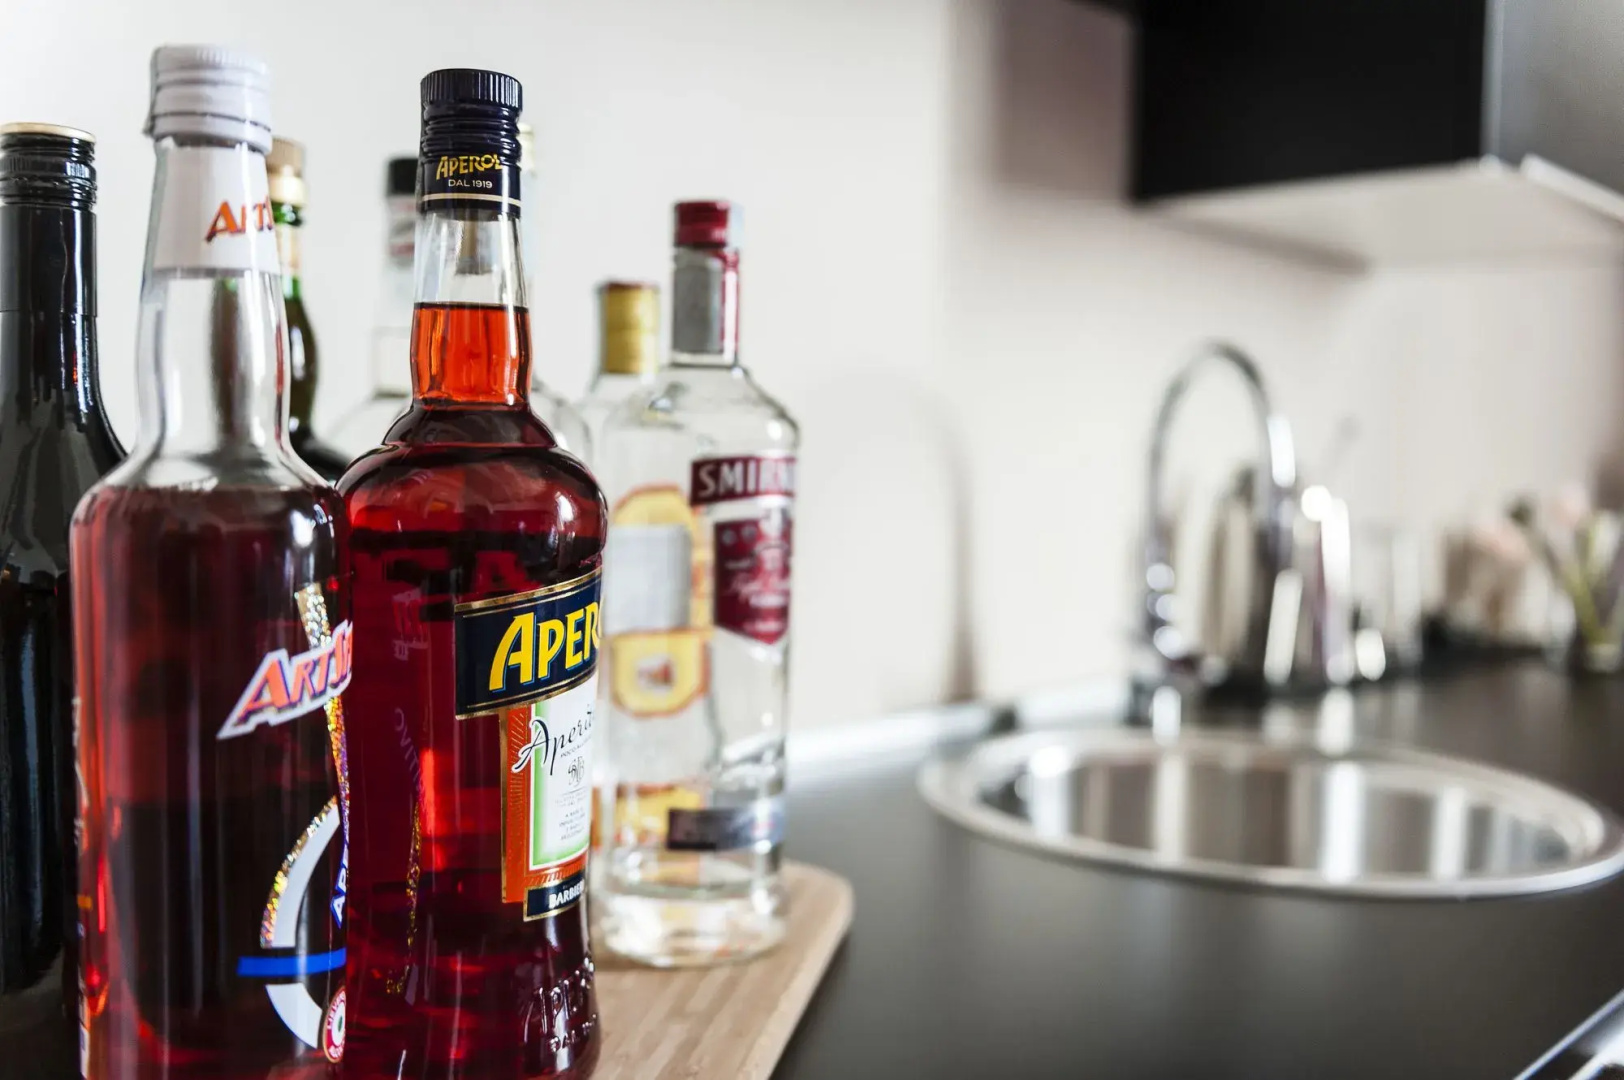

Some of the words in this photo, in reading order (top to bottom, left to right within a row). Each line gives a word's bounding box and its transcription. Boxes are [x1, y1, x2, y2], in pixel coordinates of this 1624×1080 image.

[436, 154, 503, 180] APEROL
[472, 180, 493, 189] 1919
[489, 600, 604, 694] APER
